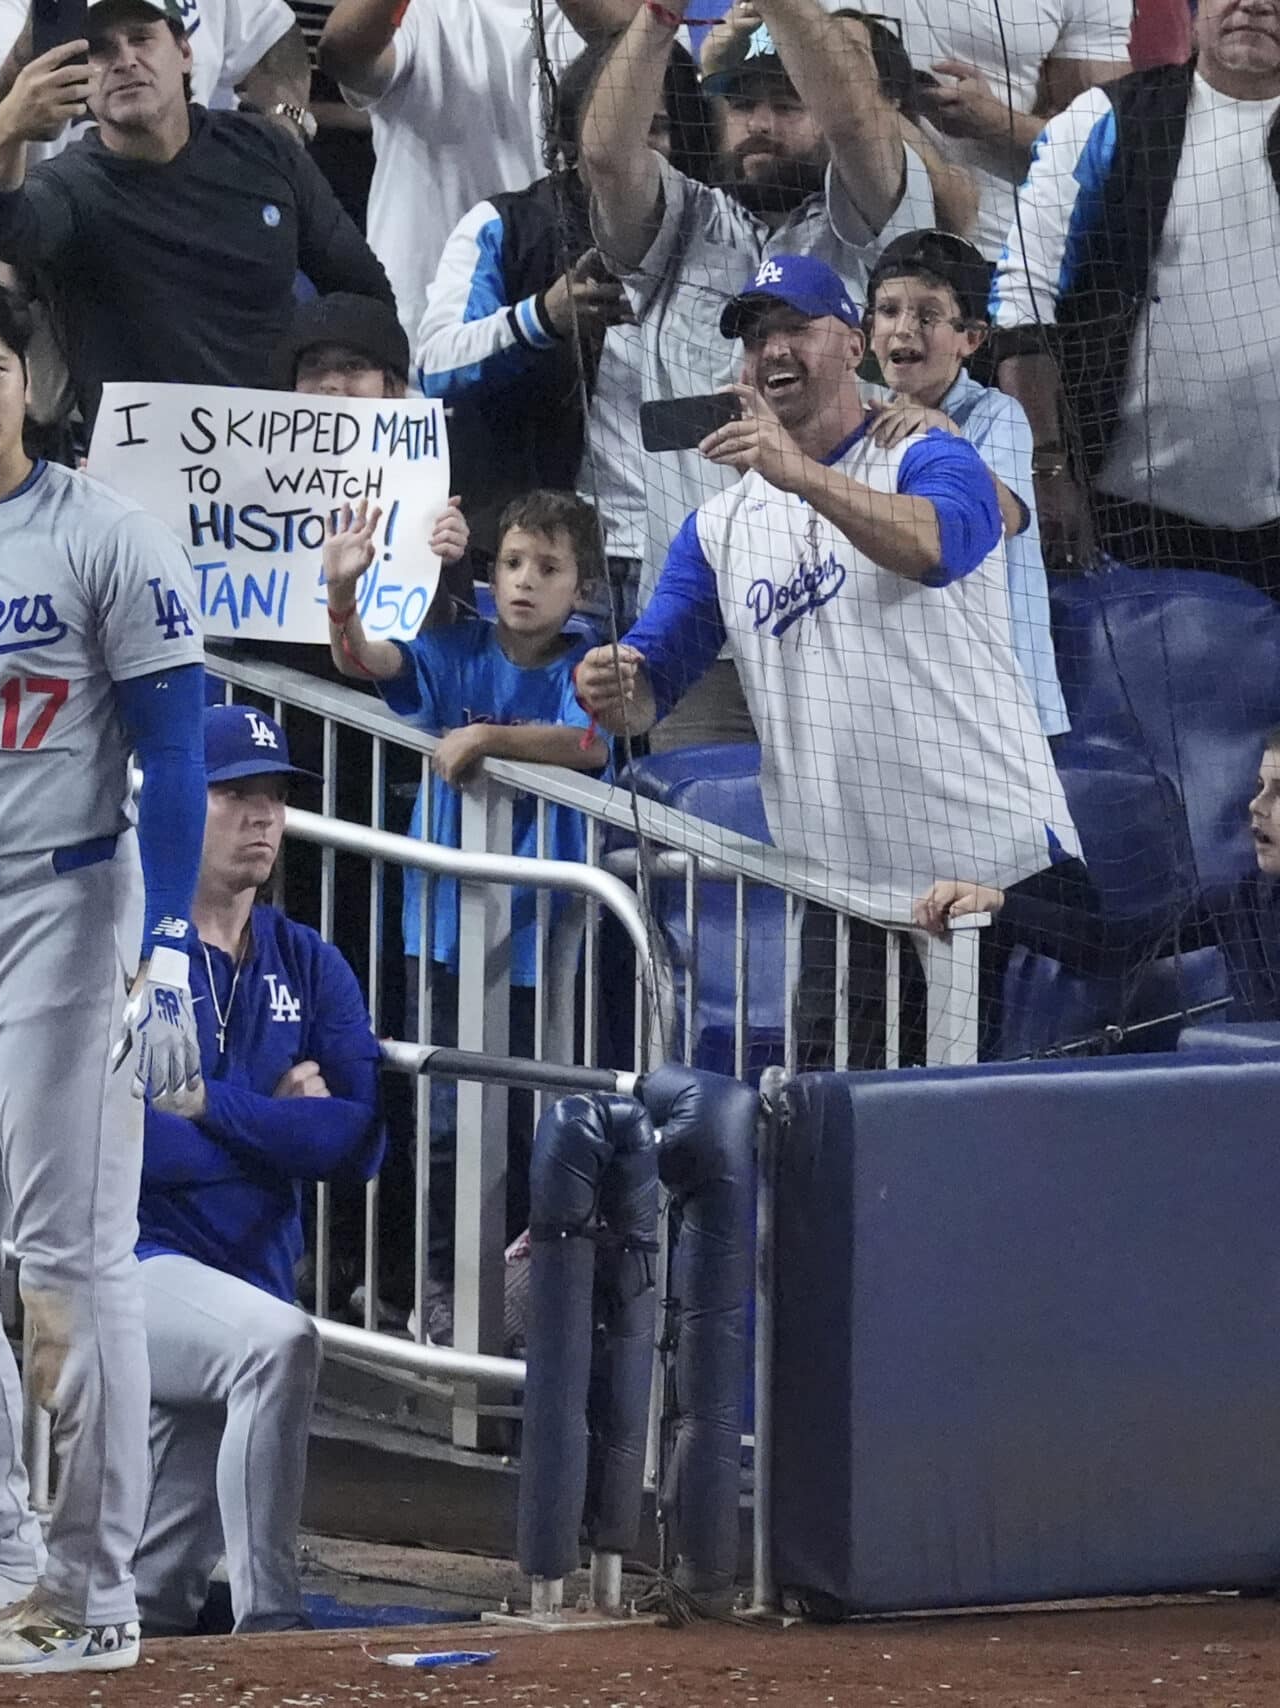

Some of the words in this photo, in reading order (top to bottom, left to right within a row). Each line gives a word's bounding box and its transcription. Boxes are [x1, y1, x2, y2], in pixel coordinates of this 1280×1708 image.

[755, 259, 783, 288] LA
[113, 402, 151, 447] I
[180, 406, 360, 456] SKIPPED
[372, 408, 440, 460] MATH
[180, 464, 222, 494] TO
[265, 467, 384, 499] WATCH
[147, 577, 194, 640] LA
[746, 552, 847, 637] Dodgers
[0, 677, 70, 750] 17
[244, 713, 279, 749] LA
[263, 975, 301, 1022] LA
